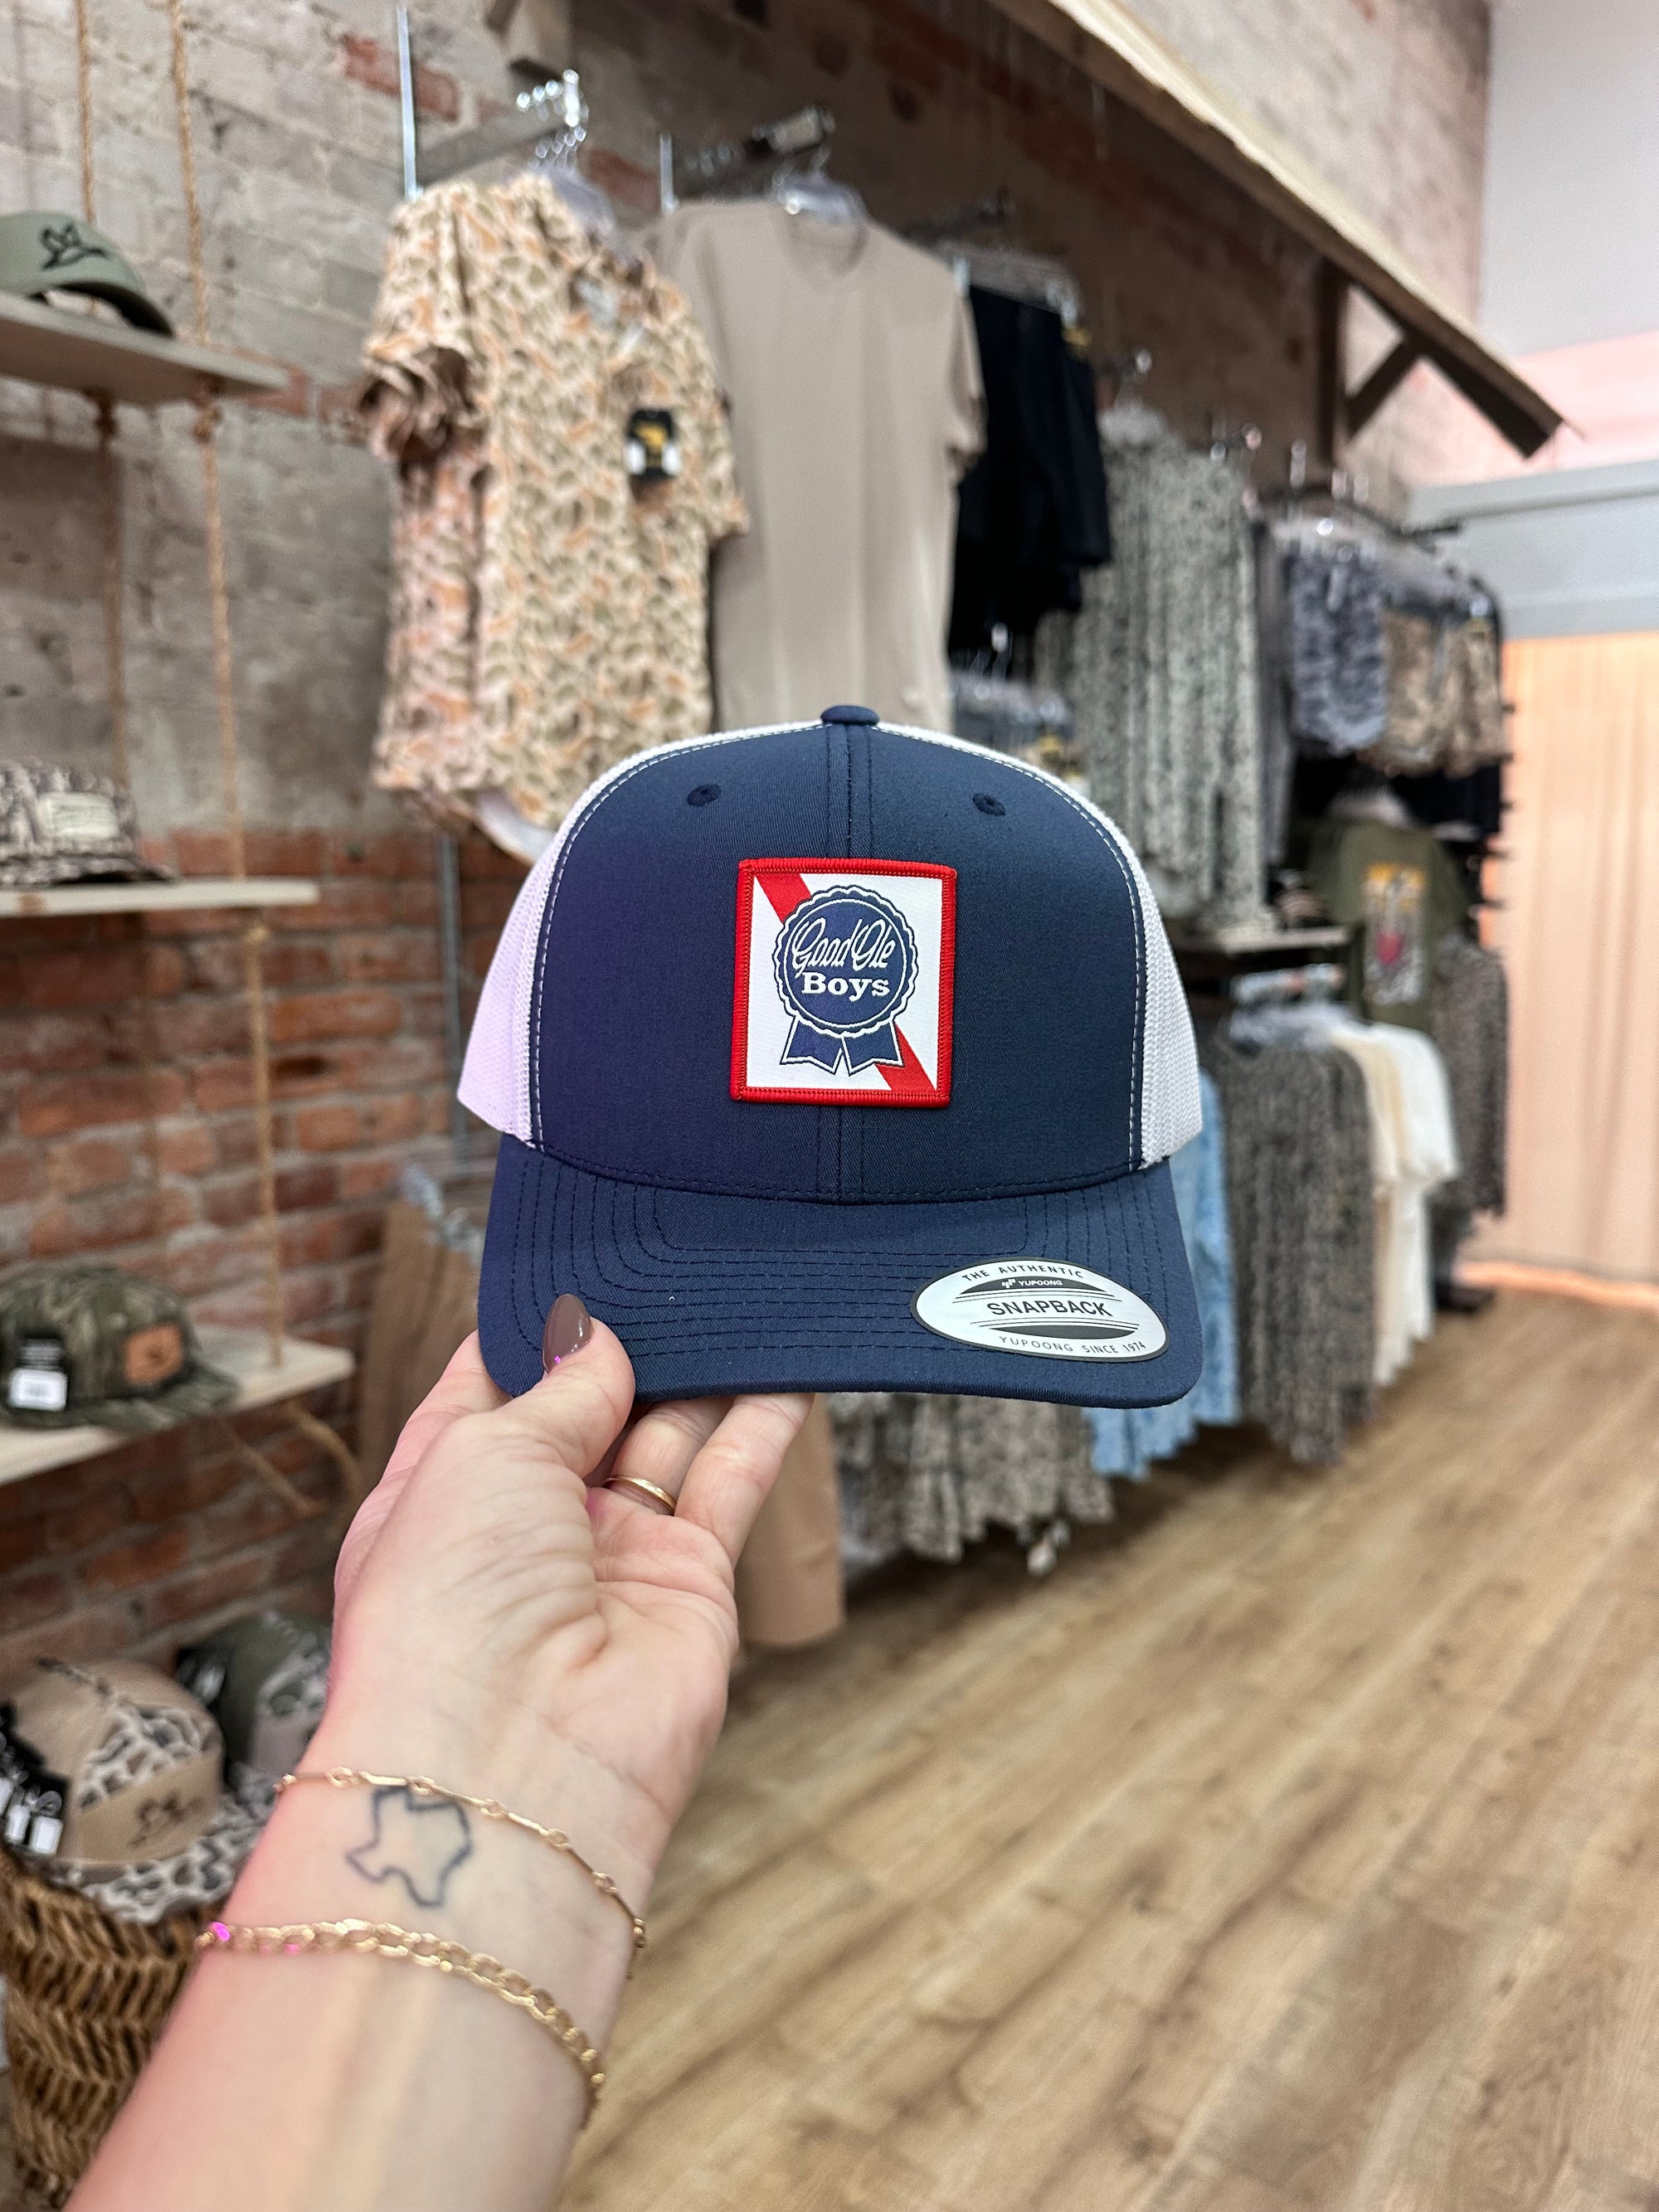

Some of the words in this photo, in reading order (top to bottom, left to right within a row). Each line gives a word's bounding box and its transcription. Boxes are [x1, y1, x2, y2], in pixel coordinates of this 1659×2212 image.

[791, 917, 862, 978] Good
[851, 918, 896, 971] Ole
[801, 971, 890, 1002] Boys
[961, 1269, 990, 1282] THE
[999, 1264, 1084, 1279] AUTHENTIC
[986, 1300, 1113, 1317] SNAPBACK
[999, 1335, 1073, 1352] YUPOONG
[1082, 1344, 1117, 1354] SINCE
[1123, 1340, 1146, 1353] 1974
